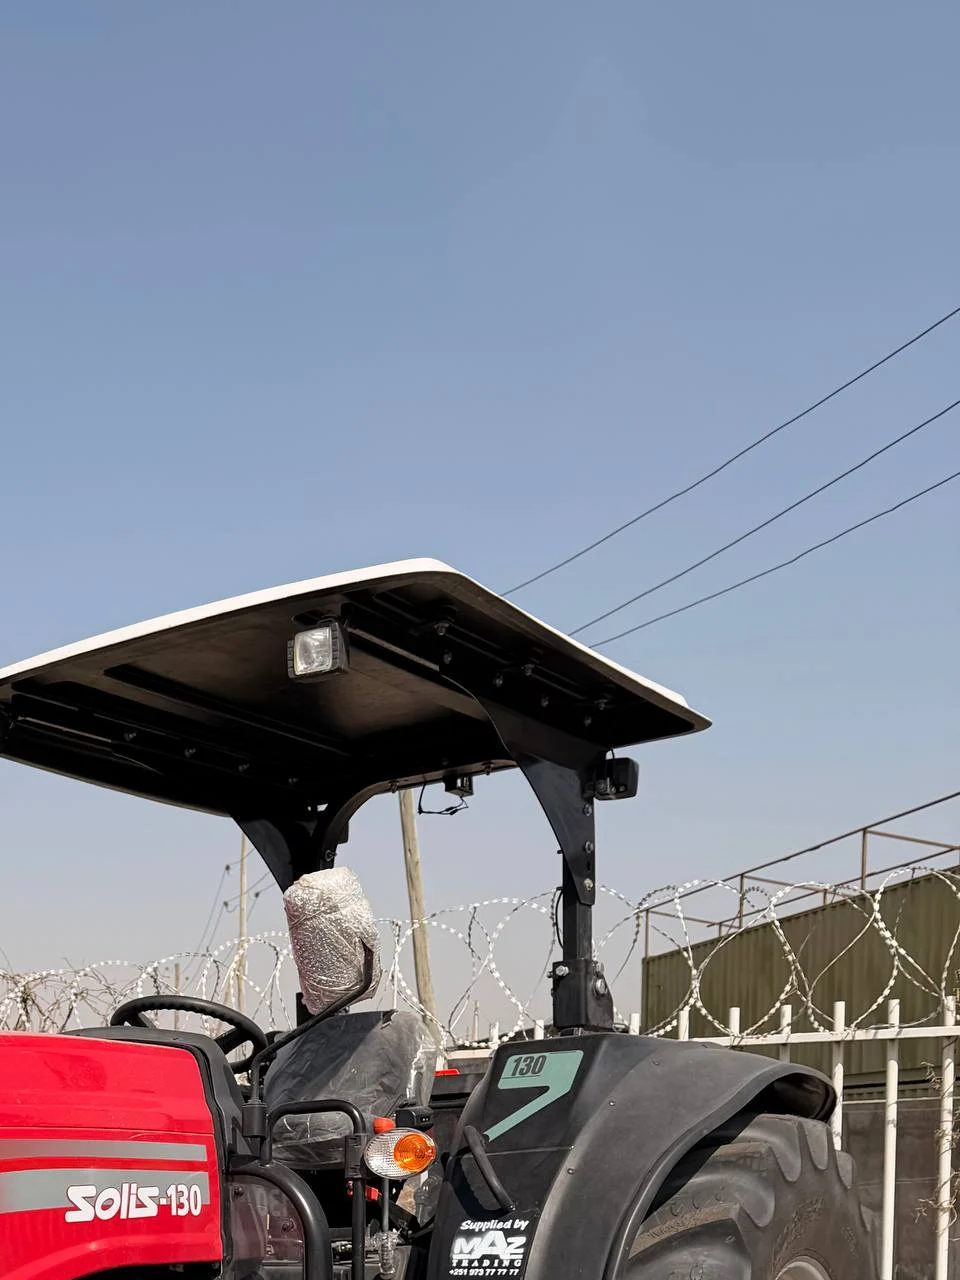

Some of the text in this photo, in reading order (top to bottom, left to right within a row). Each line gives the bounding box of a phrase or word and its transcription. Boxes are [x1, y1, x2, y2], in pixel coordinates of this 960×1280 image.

[511, 1054, 547, 1077] 130
[460, 1219, 529, 1232] Supplied by
[452, 1230, 527, 1259] MAZ
[451, 1259, 522, 1267] TRADING
